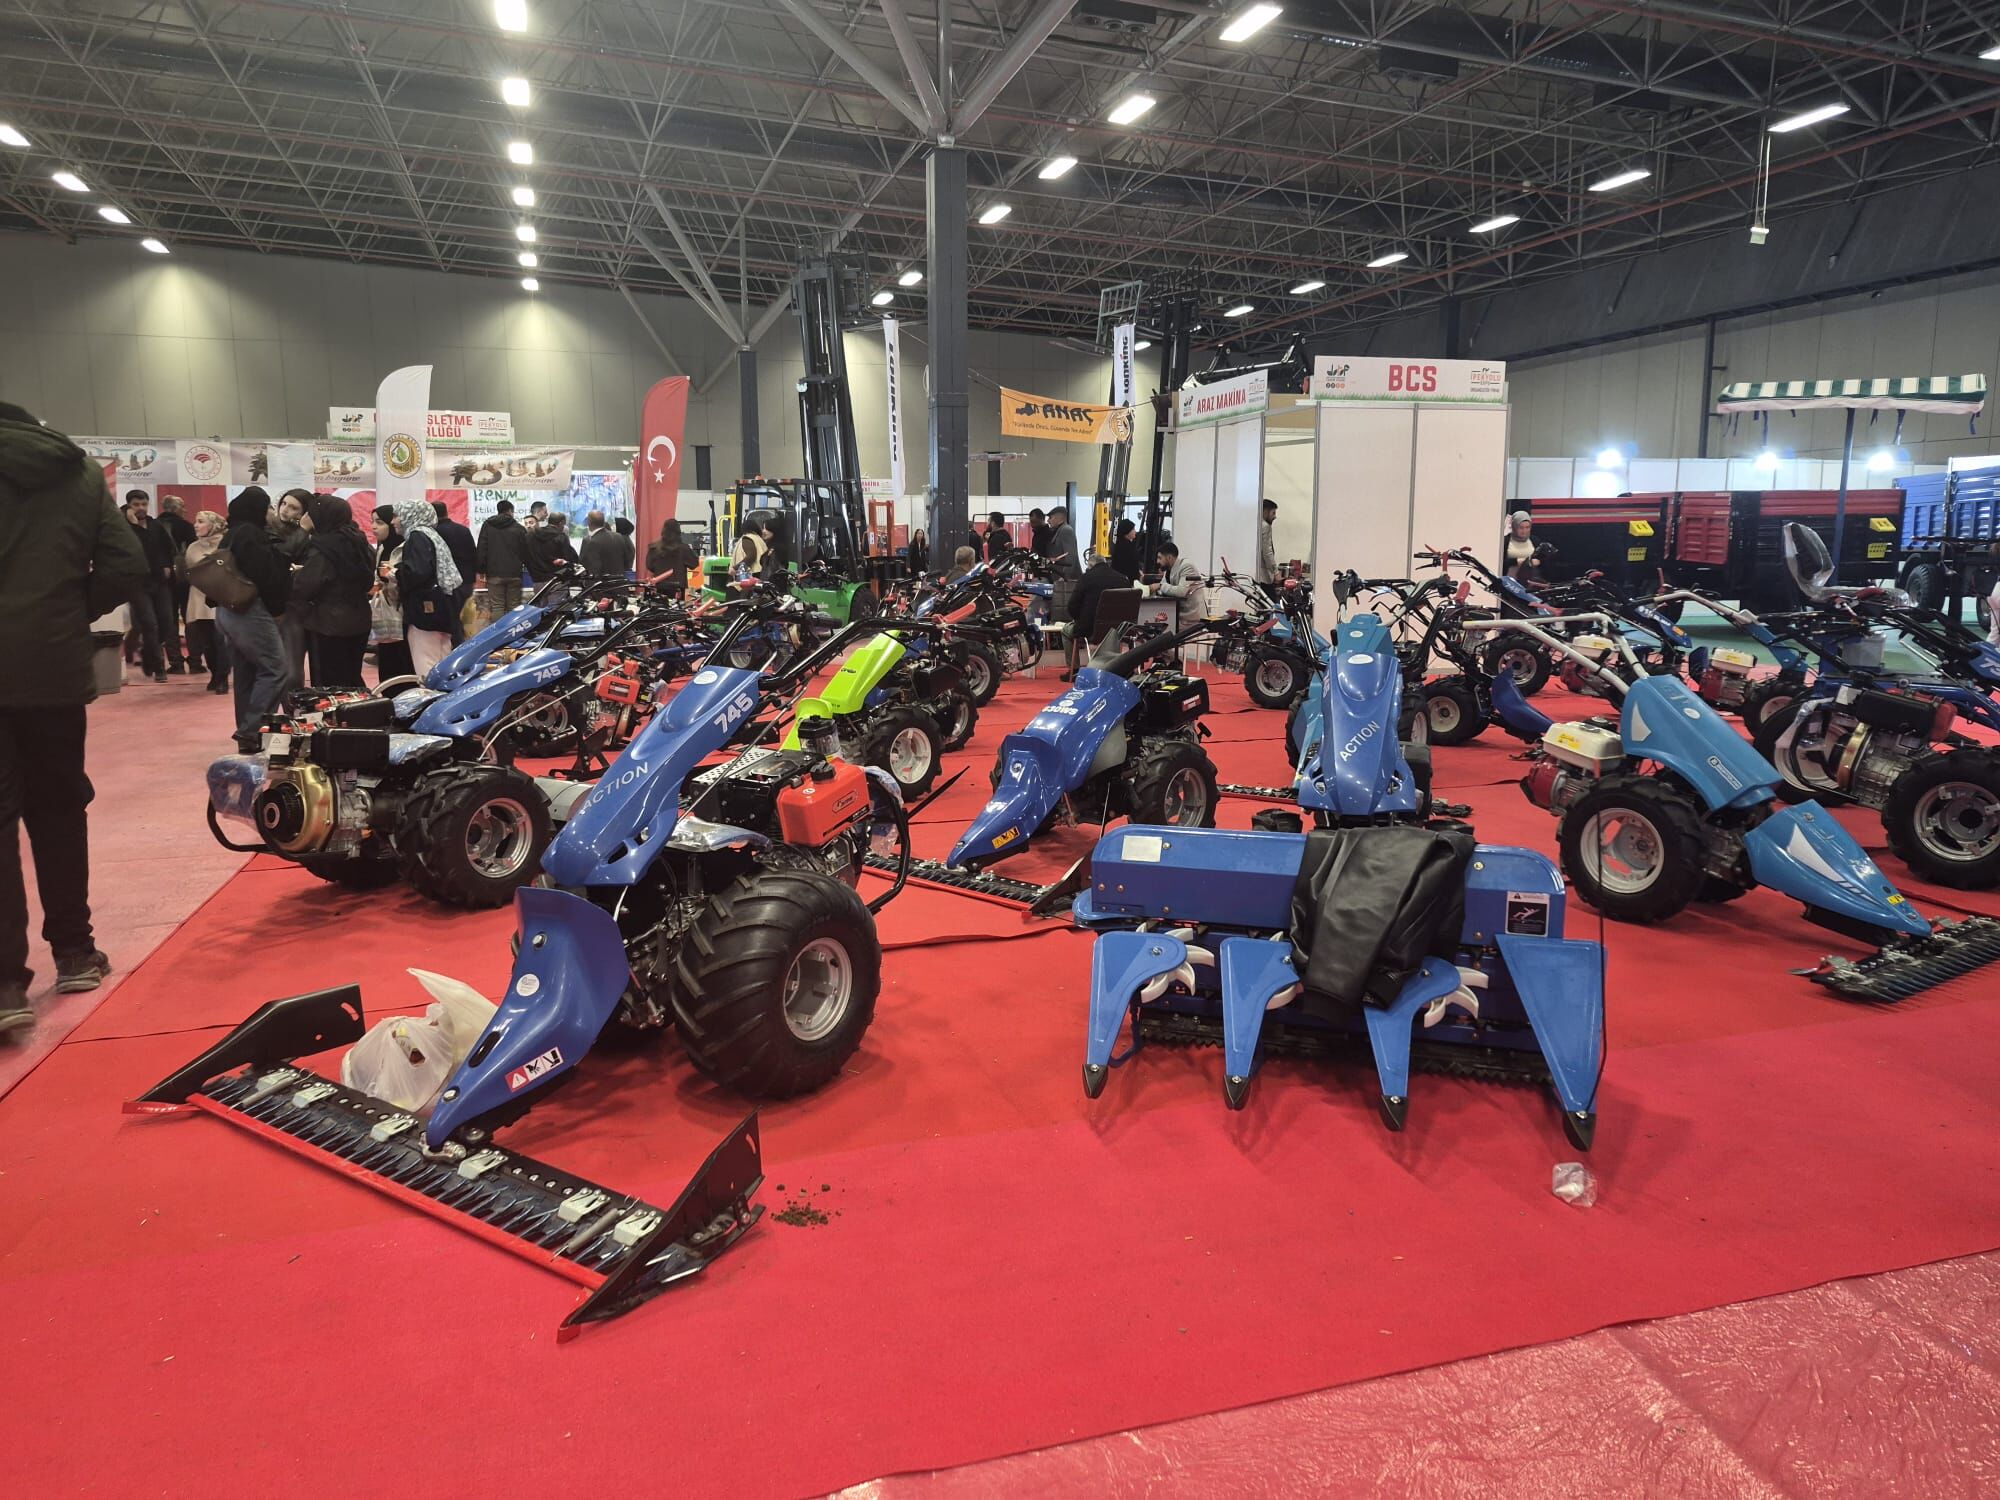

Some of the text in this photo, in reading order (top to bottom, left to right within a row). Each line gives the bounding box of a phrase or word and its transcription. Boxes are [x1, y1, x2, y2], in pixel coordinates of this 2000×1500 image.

[1388, 364, 1437, 392] BCS
[1197, 395, 1215, 414] ARAZ
[1216, 387, 1246, 410] MAKİNA
[427, 414, 473, 427] ŞLETME
[1042, 403, 1094, 426] ANAÇ
[508, 620, 532, 638] 745
[532, 665, 562, 684] 745
[712, 691, 754, 734] 745
[1339, 720, 1381, 762] ACTION
[582, 761, 649, 812] ACTION
